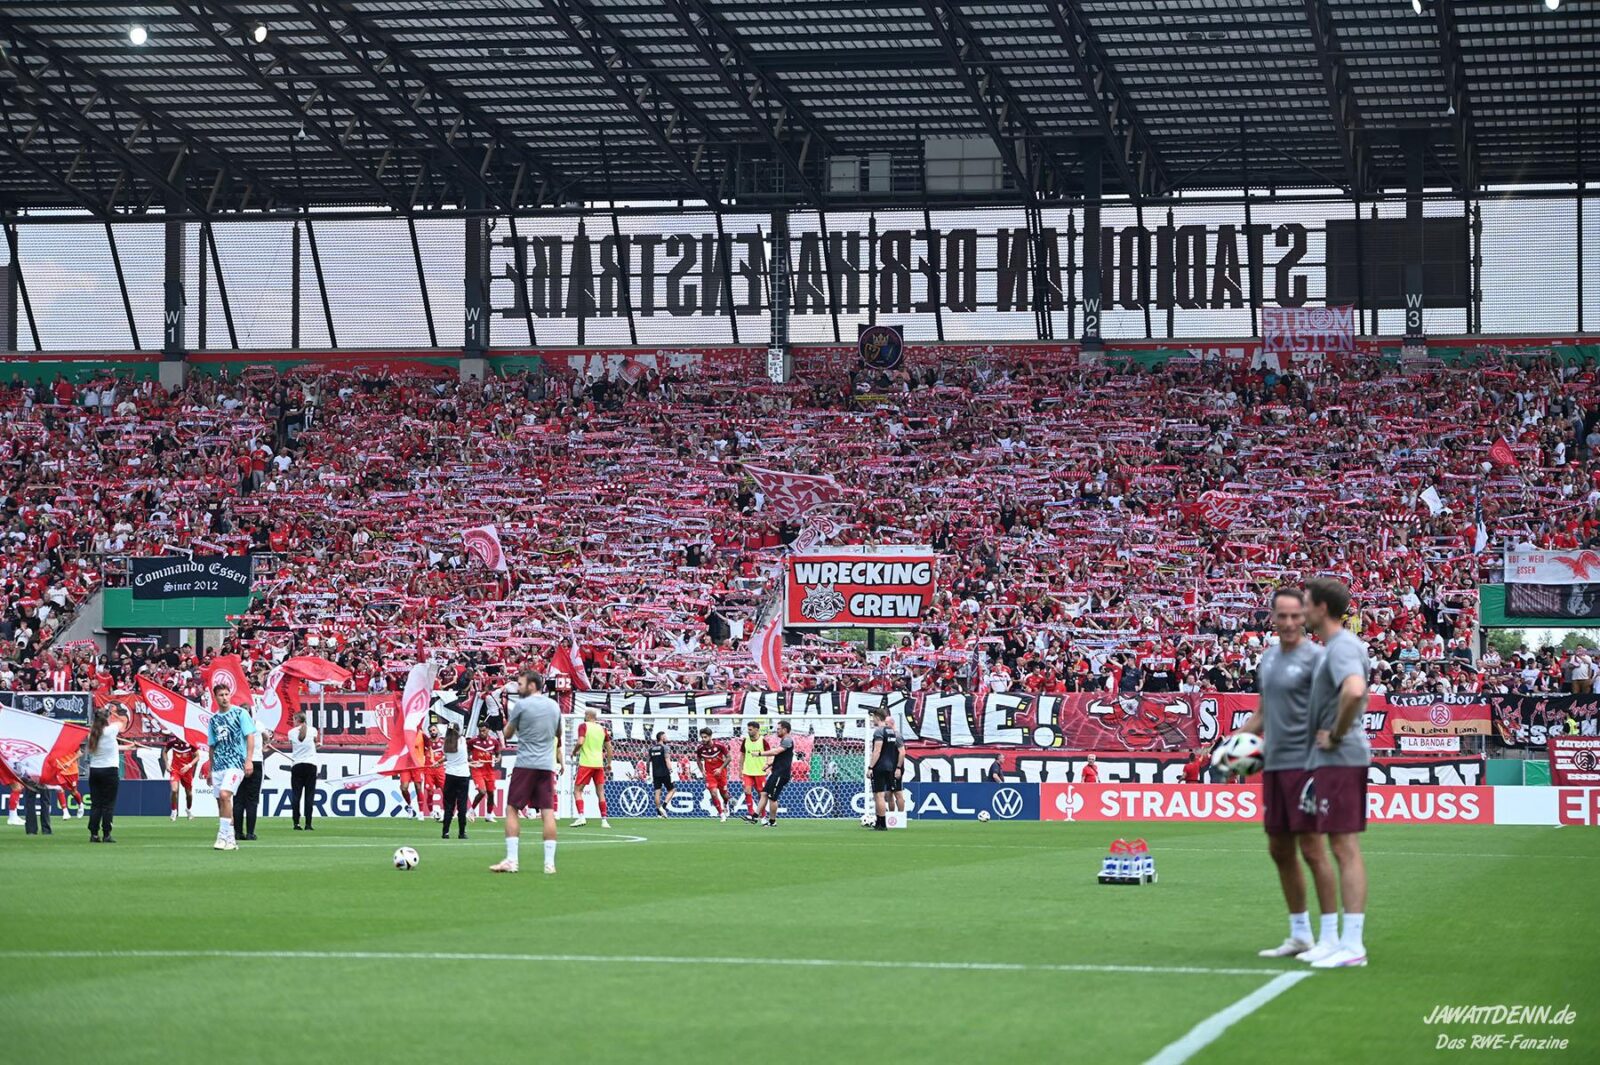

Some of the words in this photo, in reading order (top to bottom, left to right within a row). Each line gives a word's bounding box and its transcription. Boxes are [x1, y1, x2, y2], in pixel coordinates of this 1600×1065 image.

[1084, 299, 1100, 312] W
[1406, 294, 1423, 308] W
[165, 311, 180, 325] W
[465, 308, 480, 321] W
[1408, 311, 1420, 328] 3
[1086, 315, 1097, 331] 2
[168, 327, 175, 343] 1
[468, 325, 476, 340] 1
[1263, 330, 1354, 352] KASTEN
[134, 560, 205, 587] Commando
[208, 562, 248, 585] Essen
[794, 562, 931, 585] WRECKING
[163, 582, 192, 593] Since
[194, 581, 219, 591] 2012
[849, 593, 922, 617] CREW
[1100, 790, 1257, 818] STRAUSS
[1366, 792, 1480, 820] RAUSS
